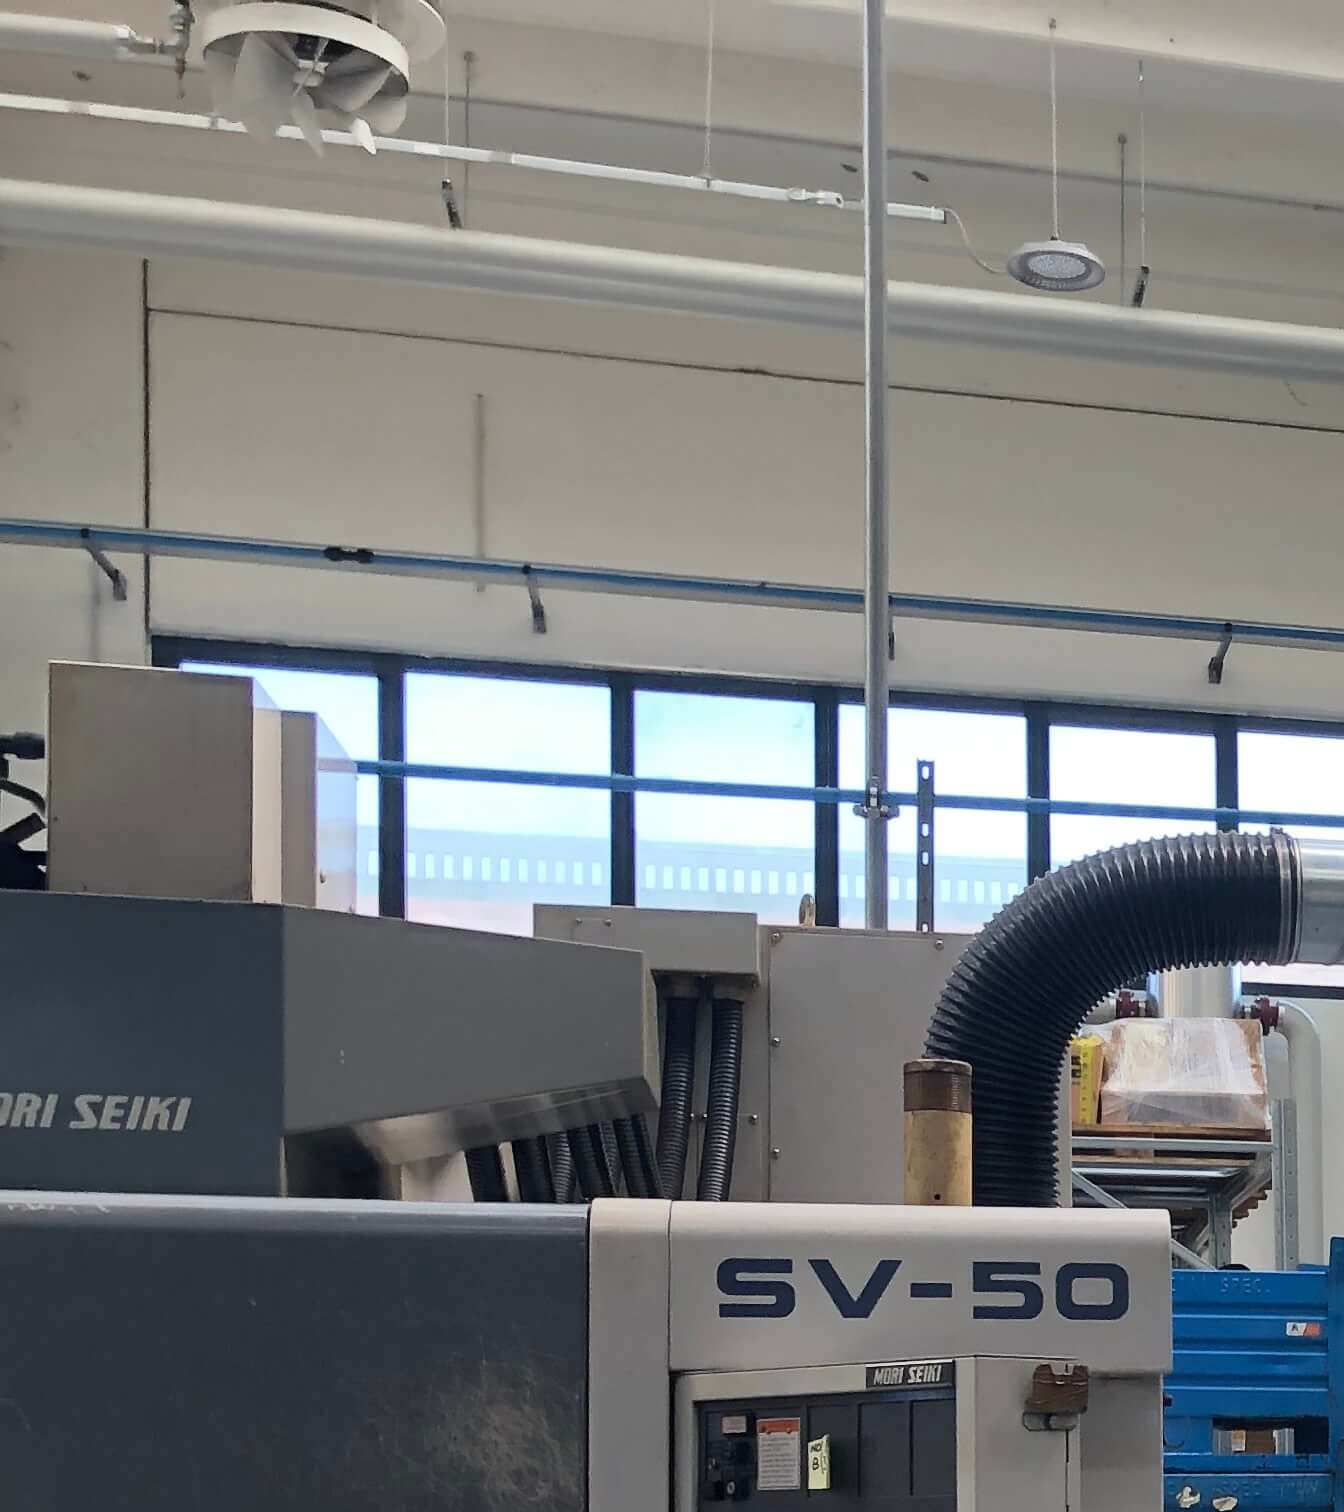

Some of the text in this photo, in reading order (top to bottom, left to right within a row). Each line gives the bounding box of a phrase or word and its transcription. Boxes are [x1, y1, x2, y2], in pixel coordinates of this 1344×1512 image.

[69, 1094, 192, 1131] SEIKI
[716, 1257, 1130, 1320] SV-50
[873, 1364, 942, 1386] MORI SEIKI
